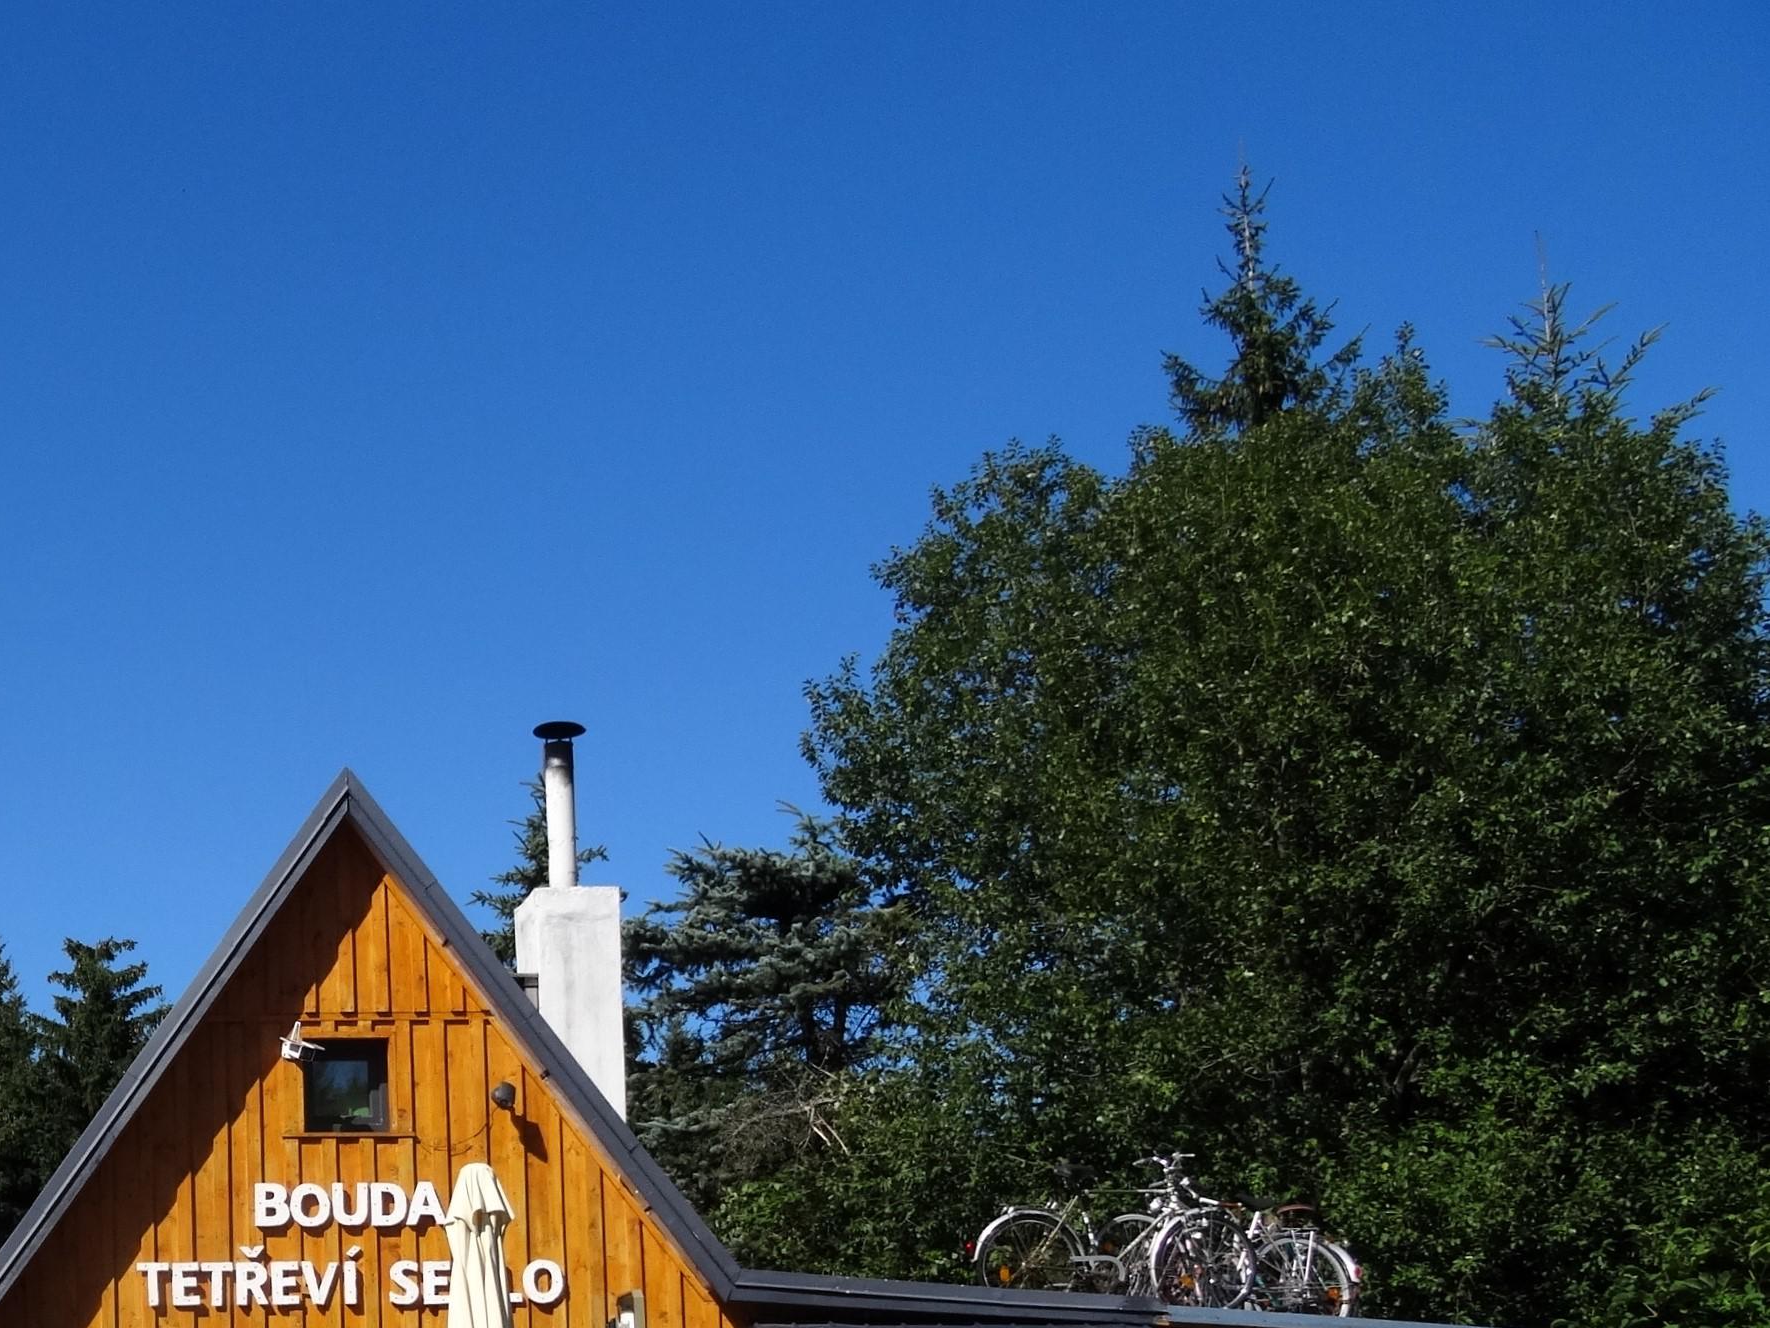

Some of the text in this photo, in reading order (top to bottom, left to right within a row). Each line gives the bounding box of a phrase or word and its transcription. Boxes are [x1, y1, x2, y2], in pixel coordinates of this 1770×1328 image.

[253, 1180, 447, 1228] BOUDA
[136, 1244, 566, 1307] TETŘEVÍ SEO
